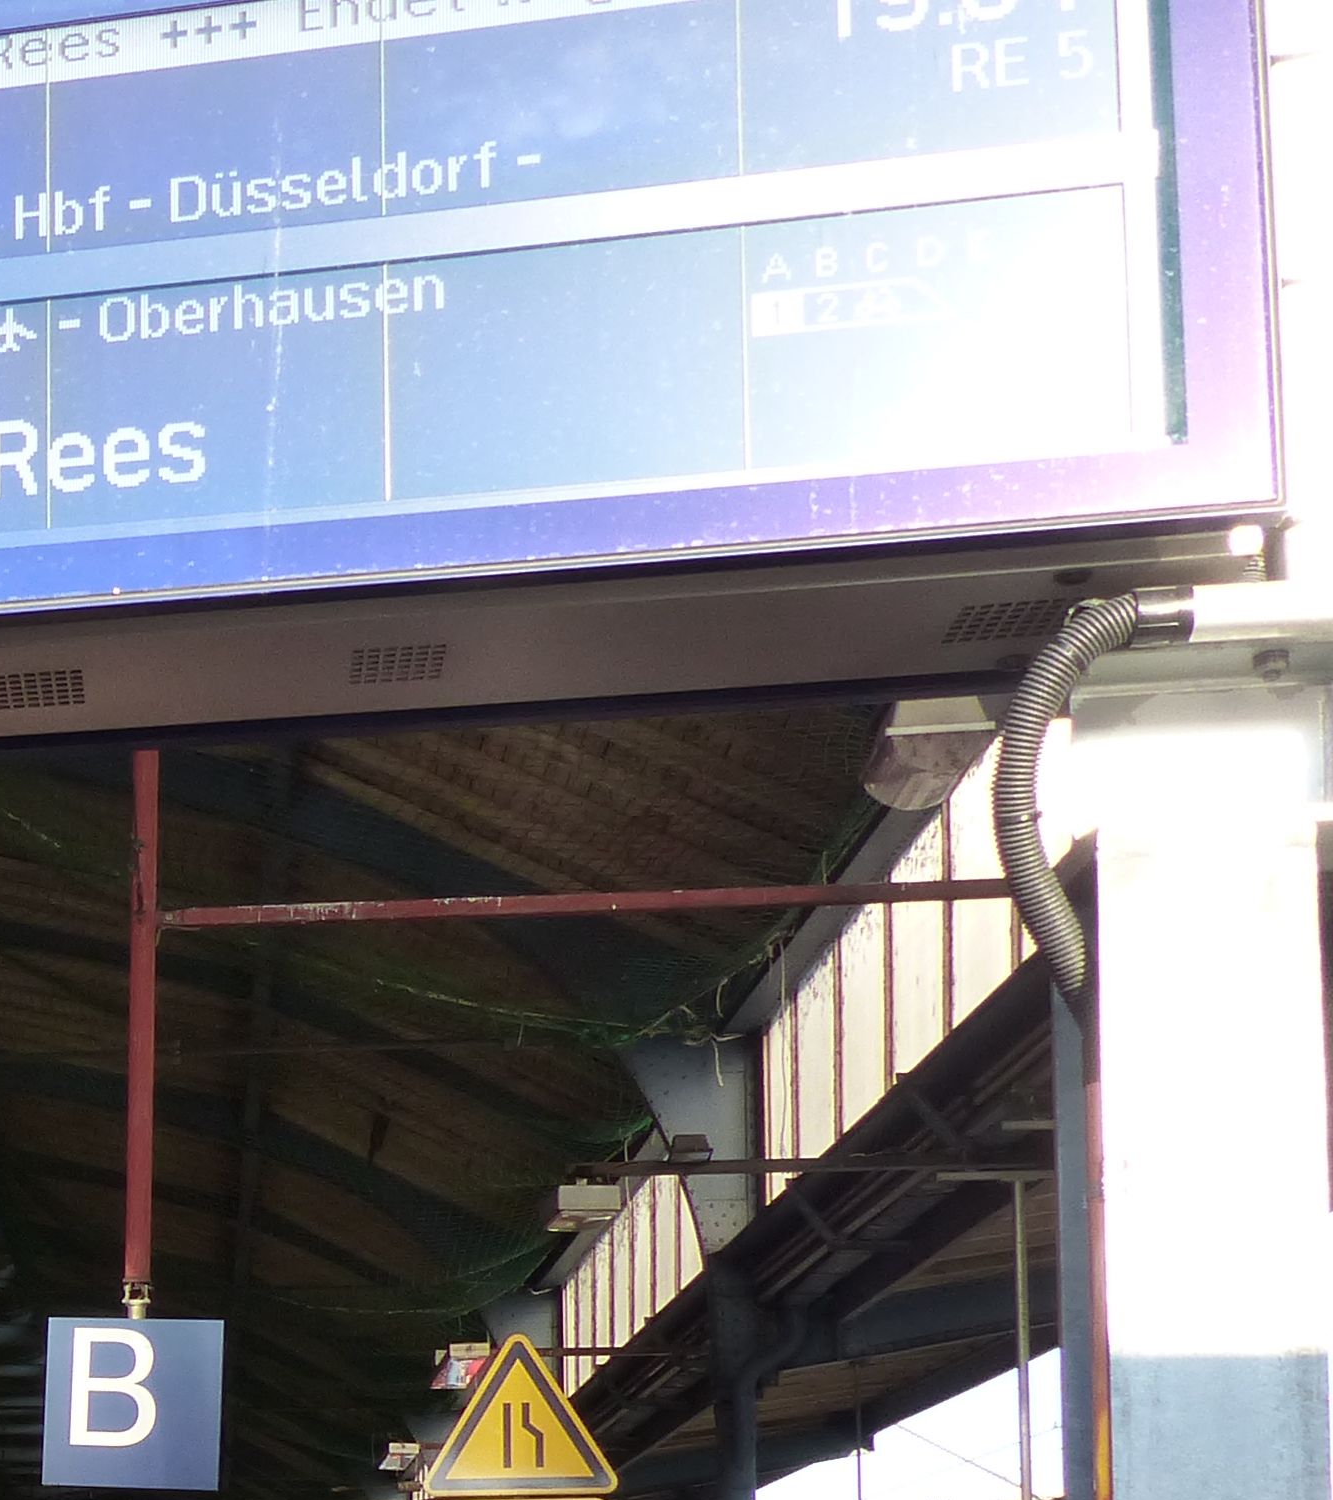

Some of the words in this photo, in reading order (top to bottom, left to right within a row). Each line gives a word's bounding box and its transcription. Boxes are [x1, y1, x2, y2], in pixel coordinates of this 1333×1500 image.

[952, 36, 1029, 92] RE
[1057, 29, 1094, 80] 5
[15, 185, 111, 240] Hbf
[169, 140, 498, 223] Düsseldorf
[761, 253, 793, 284] A
[815, 246, 839, 279] B
[865, 241, 889, 273] C
[99, 274, 445, 343] Oberhausen
[69, 1328, 156, 1447] B
